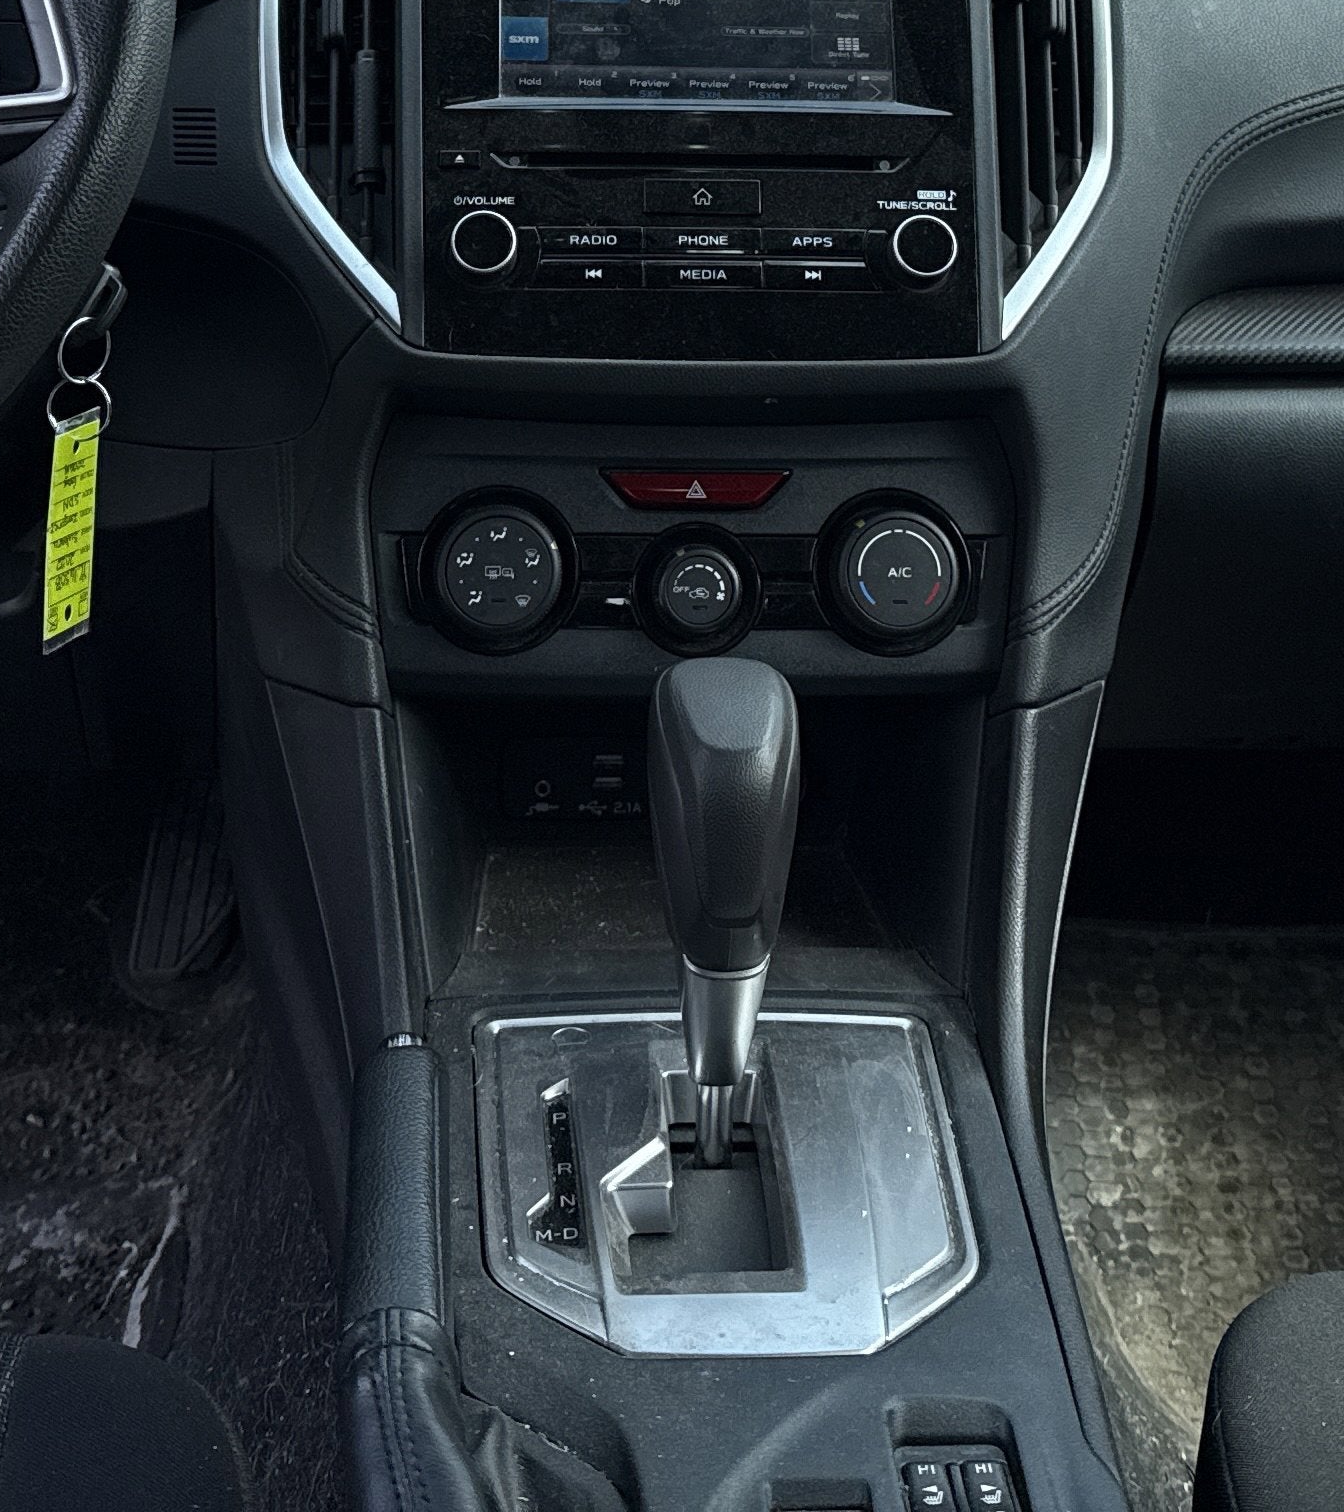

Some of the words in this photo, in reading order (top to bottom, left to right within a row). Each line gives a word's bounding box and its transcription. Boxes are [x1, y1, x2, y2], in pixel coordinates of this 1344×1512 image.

[508, 35, 540, 44] sxm
[518, 76, 542, 86] Hold
[578, 77, 602, 87] Hold
[629, 78, 671, 88] Preview
[689, 79, 730, 89] Preview
[748, 80, 789, 89] Preview
[807, 81, 848, 90] Preview
[876, 200, 957, 211] TUNE/SCROLL
[569, 234, 618, 246] RADIO
[677, 234, 729, 246] PHONE
[792, 236, 833, 248] APPS
[679, 269, 727, 281] MEDIA
[887, 566, 912, 579] A/C
[552, 1111, 567, 1125] P
[557, 1162, 572, 1175] R
[559, 1193, 576, 1208] N
[917, 1464, 936, 1475] HI
[974, 1462, 993, 1474] HI
